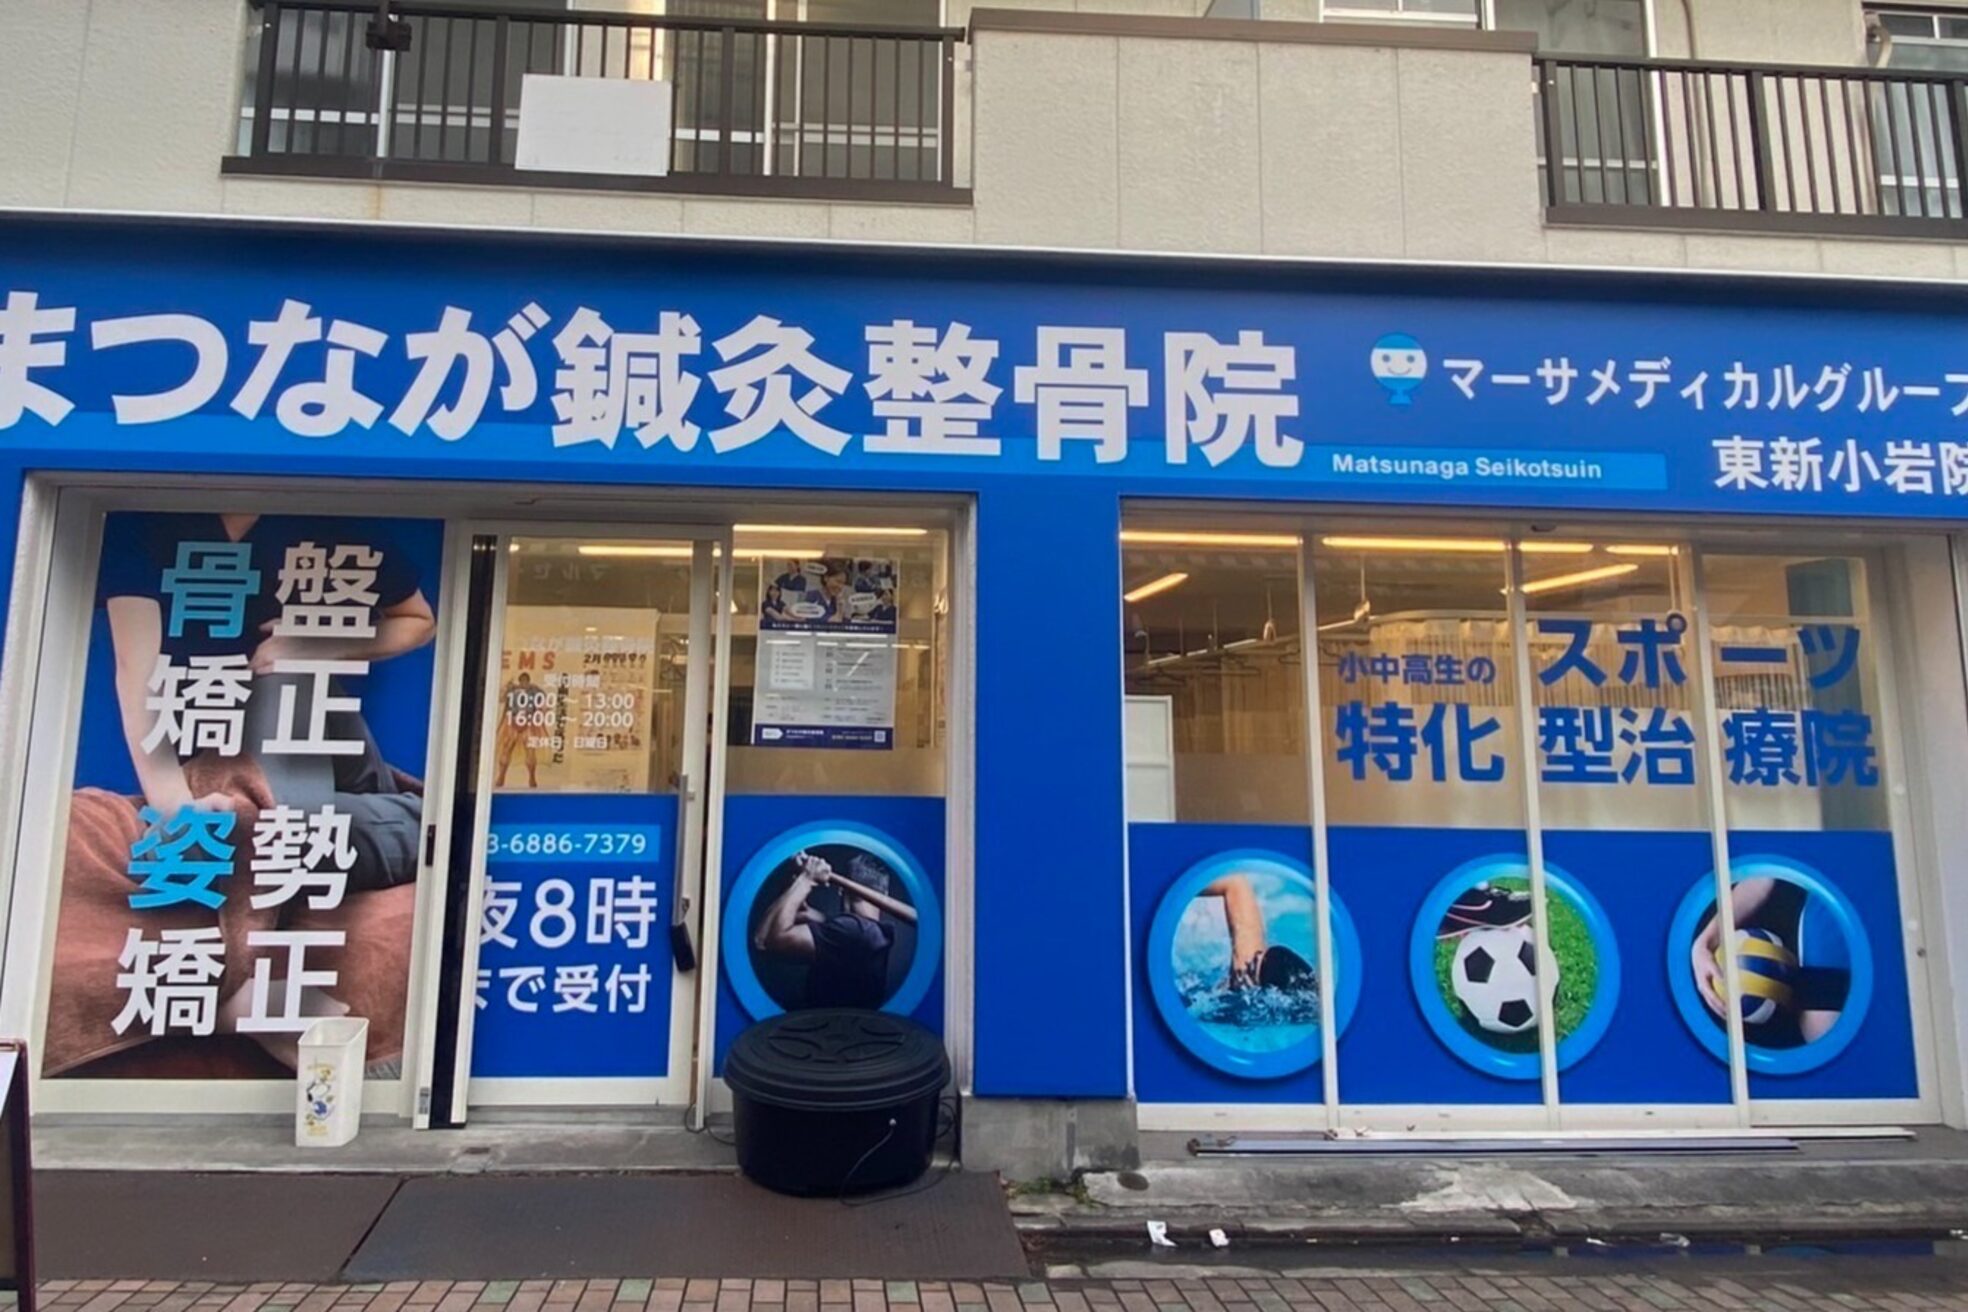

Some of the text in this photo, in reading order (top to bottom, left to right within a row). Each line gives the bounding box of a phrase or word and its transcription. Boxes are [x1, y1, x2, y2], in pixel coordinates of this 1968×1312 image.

[0, 290, 1304, 468] まつなが鍼灸整骨院
[1332, 453, 1602, 480] Matsunaga Seikotsuin
[160, 541, 384, 639] 骨盤
[1337, 611, 1861, 689] 小中高生の スポーツ
[140, 653, 371, 757] 矯正
[506, 711, 556, 727] 16:00
[583, 711, 634, 727] 20:00
[507, 692, 556, 709] 10:00
[586, 693, 635, 709] 13:00
[1335, 699, 1879, 788] 特化型治療院
[127, 803, 358, 911] 姿勢
[111, 927, 346, 1037] 矯正
